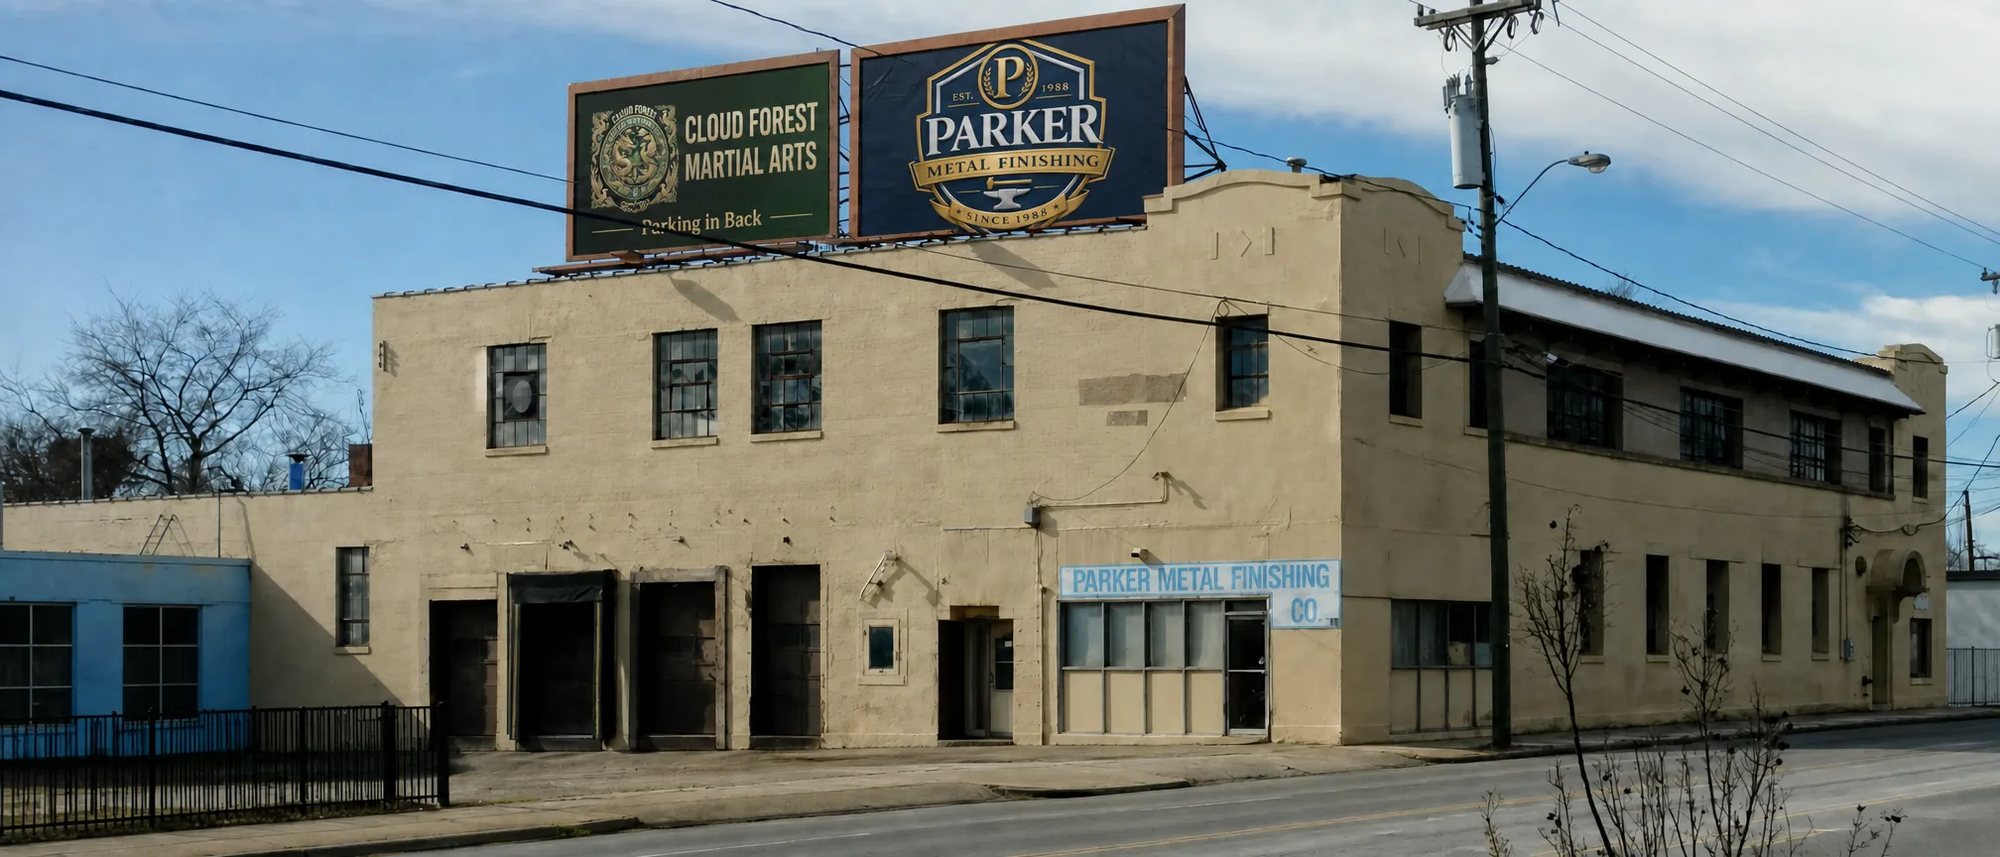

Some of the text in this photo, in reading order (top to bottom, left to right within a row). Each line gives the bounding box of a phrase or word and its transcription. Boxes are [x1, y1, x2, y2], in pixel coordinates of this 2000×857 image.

[952, 82, 1070, 101] EST. 1988
[994, 56, 1025, 99] P
[685, 110, 743, 144] CLOUD
[749, 101, 818, 137] FOREST
[926, 104, 1104, 157] PARKER
[685, 141, 817, 181] MARTIAL ARTS
[927, 154, 1099, 179] METAL FINISHING
[641, 208, 762, 236] Parking in Back
[966, 209, 1048, 225] SINCE 1988
[1072, 563, 1330, 593] PARKER METAL FINISHING
